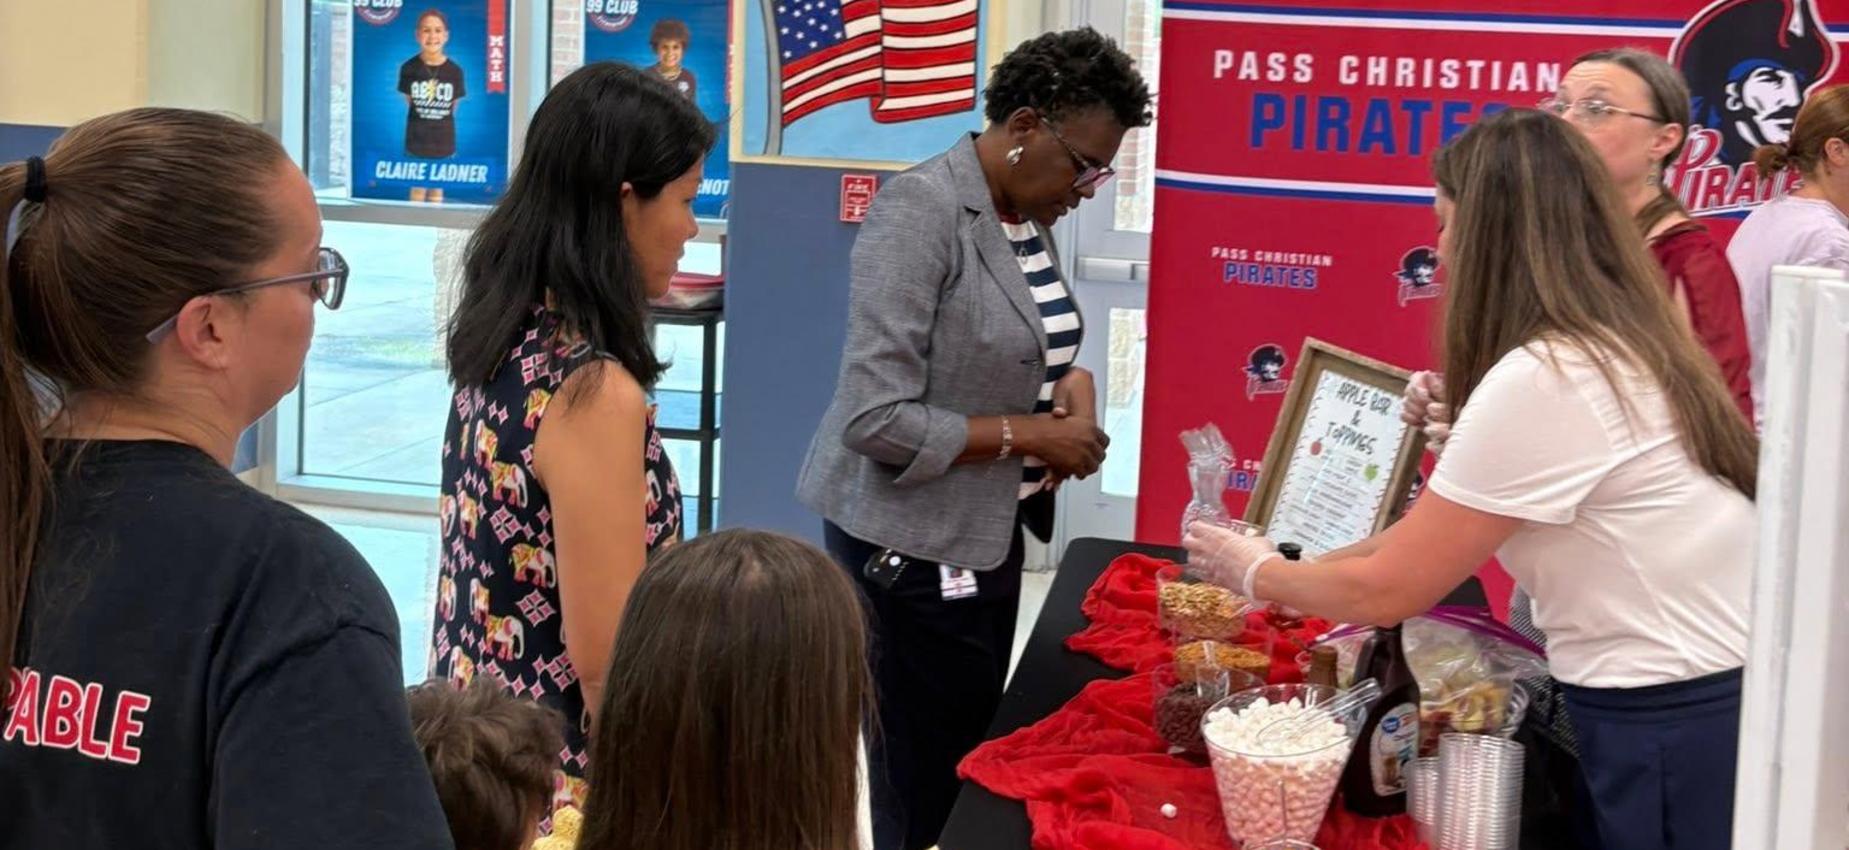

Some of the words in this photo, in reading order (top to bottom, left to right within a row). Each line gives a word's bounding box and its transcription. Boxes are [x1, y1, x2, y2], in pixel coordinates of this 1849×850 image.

[586, 0, 603, 13] 99
[605, 0, 639, 15] CLUB
[489, 35, 505, 83] MATH
[1213, 50, 1313, 83] PASS
[1338, 55, 1561, 93] CHRISTIAN
[1250, 92, 1511, 156] PIRATE
[375, 161, 428, 180] CLAIRE
[429, 163, 489, 183] LADNER
[1211, 246, 1249, 261] PASS
[1254, 250, 1333, 267] CHRISTIAN
[1223, 260, 1319, 290] PIRATES
[1336, 382, 1369, 407] APPLE
